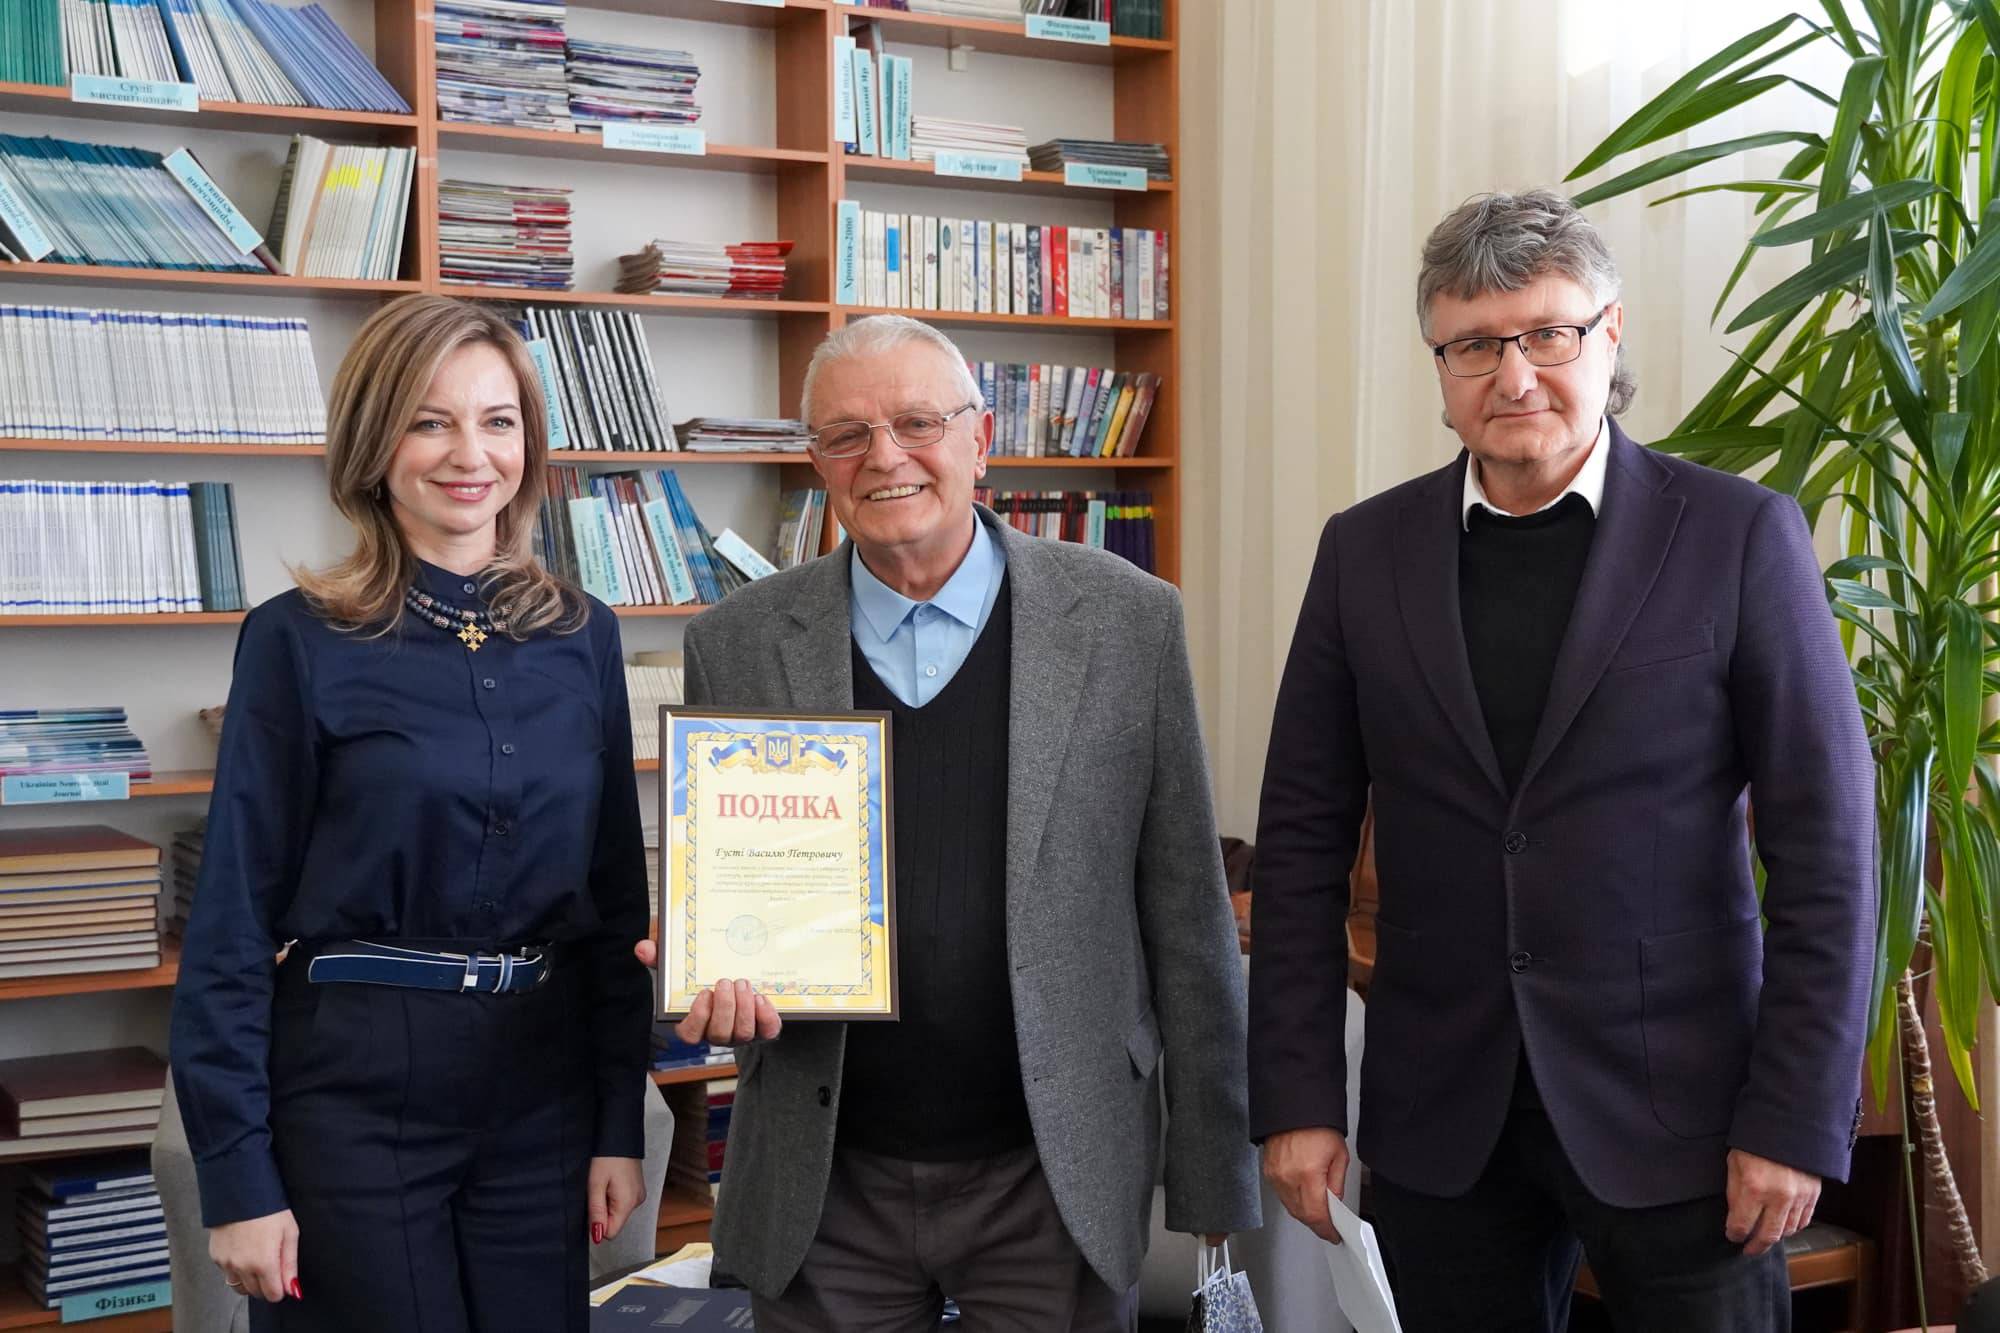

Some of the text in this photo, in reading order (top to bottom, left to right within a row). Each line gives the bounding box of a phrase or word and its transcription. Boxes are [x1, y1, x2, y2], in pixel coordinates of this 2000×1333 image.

[844, 217, 855, 288] Хроніка-2000
[717, 793, 842, 824] ПОДЯКА
[747, 848, 785, 859] Василю
[787, 849, 843, 861] Петровичу
[95, 1293, 156, 1311] Фізика
